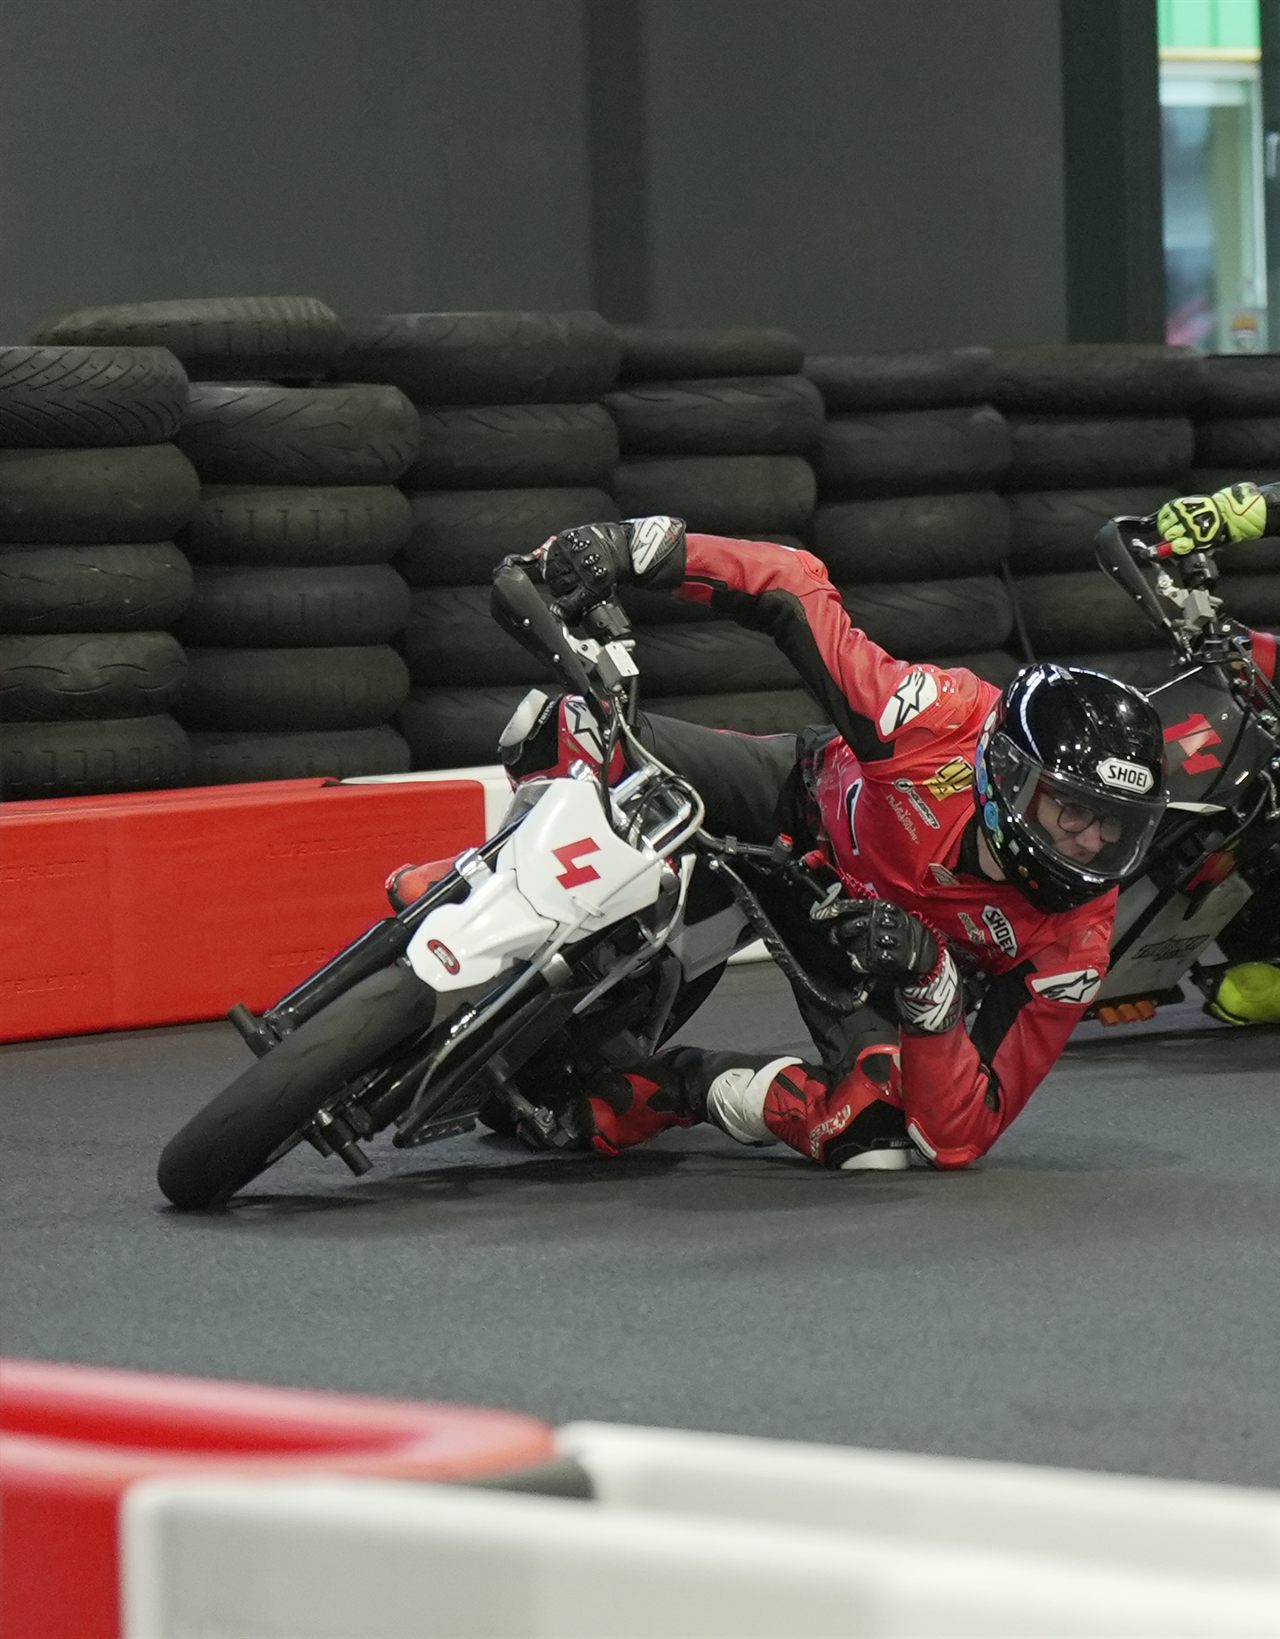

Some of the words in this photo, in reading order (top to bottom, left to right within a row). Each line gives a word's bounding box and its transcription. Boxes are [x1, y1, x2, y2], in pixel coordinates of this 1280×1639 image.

[1108, 765, 1148, 788] SHOEI
[552, 837, 601, 889] 4
[985, 910, 1015, 951] SHOEI
